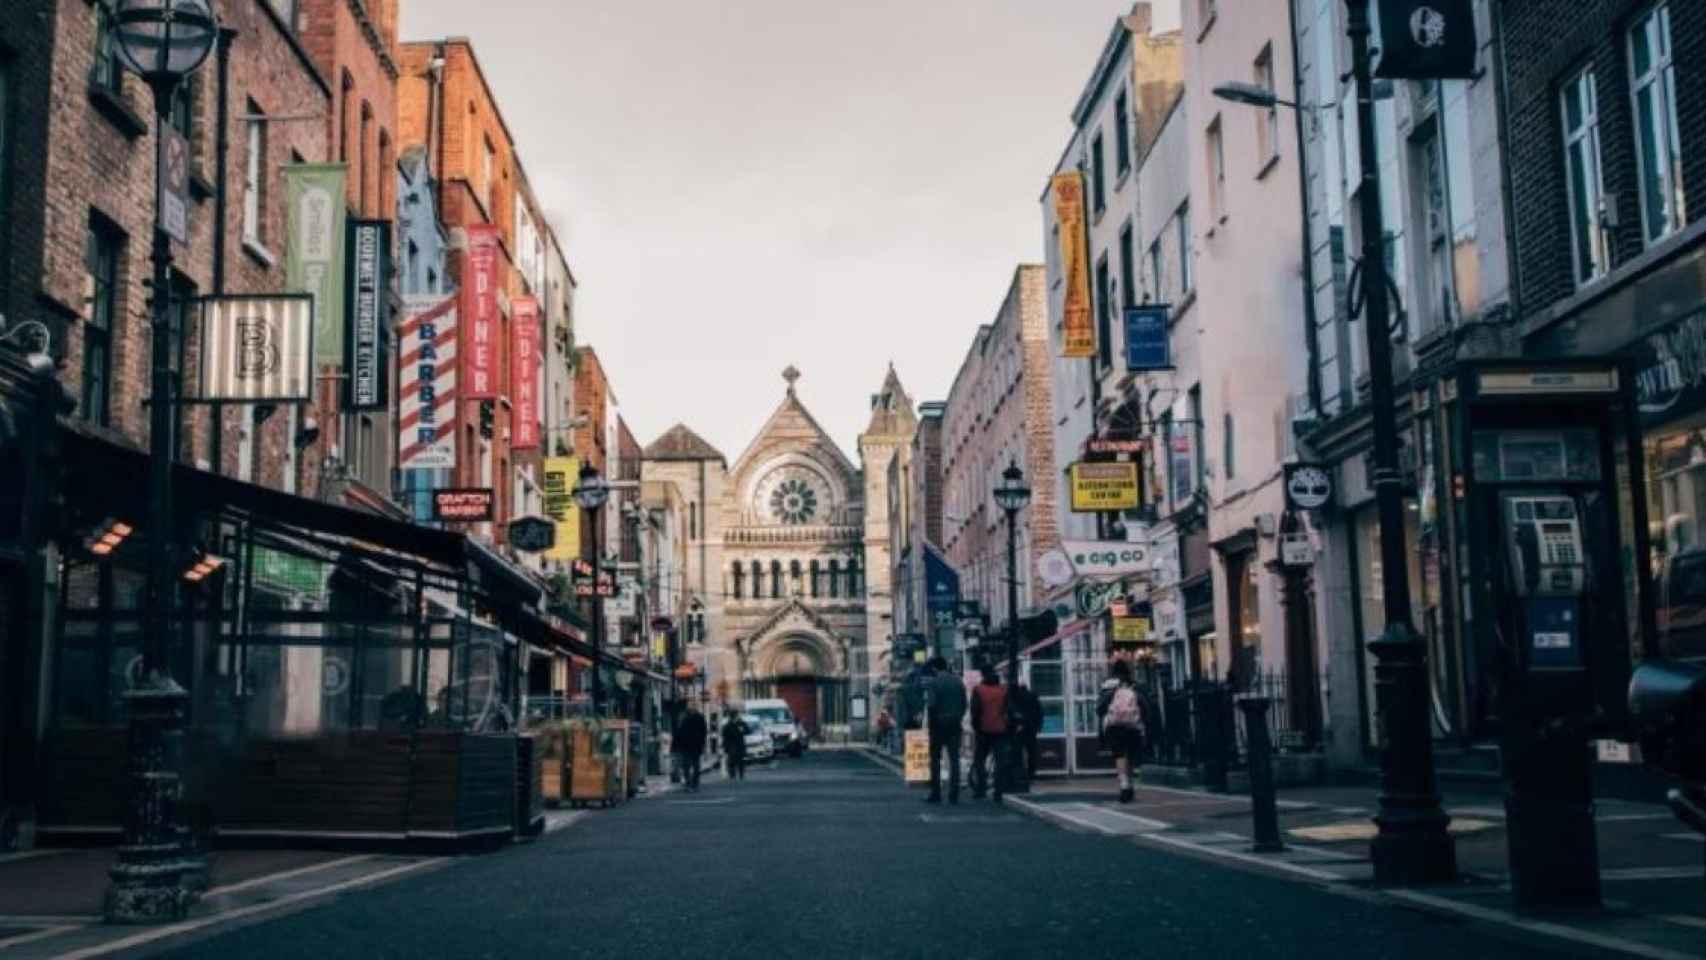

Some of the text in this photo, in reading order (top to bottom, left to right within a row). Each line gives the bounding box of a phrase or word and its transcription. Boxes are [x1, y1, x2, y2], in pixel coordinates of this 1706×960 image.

[235, 316, 281, 381] B
[357, 226, 375, 406] GOURMET BURGER KITCHEN
[473, 273, 491, 393] DINER
[418, 323, 438, 443] BARBER
[519, 340, 532, 442] DINER
[1074, 553, 1085, 565] e
